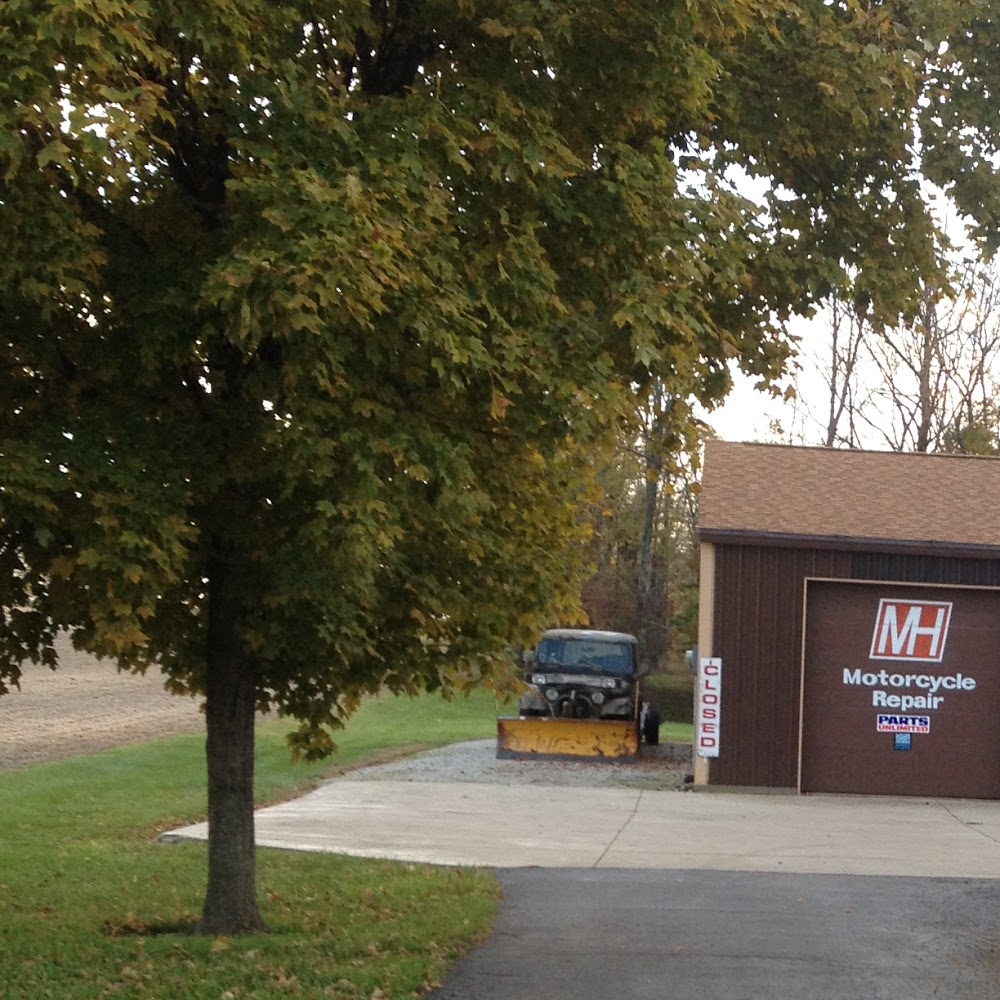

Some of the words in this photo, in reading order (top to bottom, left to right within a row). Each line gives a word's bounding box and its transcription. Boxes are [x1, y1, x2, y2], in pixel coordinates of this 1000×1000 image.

[877, 604, 945, 657] MH
[843, 668, 976, 692] Motorcycle
[700, 665, 719, 748] CLOSED
[872, 690, 944, 711] Repair
[878, 715, 928, 726] PARTS
